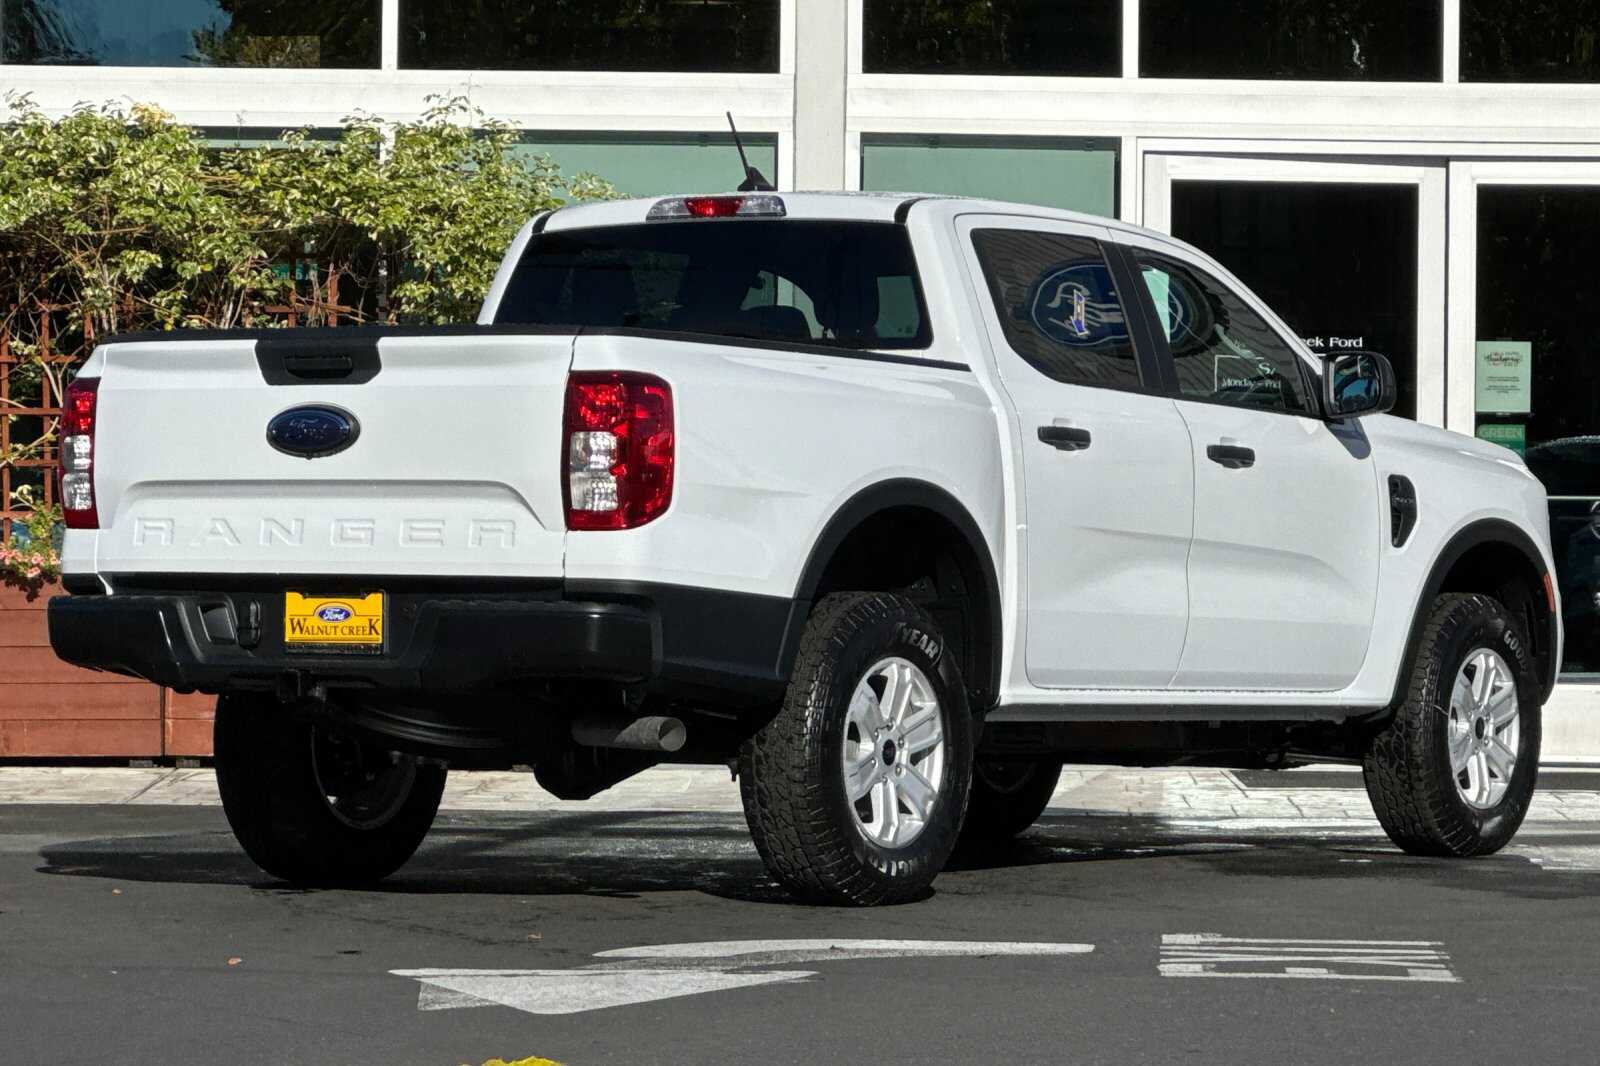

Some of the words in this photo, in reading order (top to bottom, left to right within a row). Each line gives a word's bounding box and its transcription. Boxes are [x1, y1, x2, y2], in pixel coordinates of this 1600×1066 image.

[1329, 336, 1362, 347] Ford
[132, 516, 518, 549] RANGER
[289, 617, 339, 636] WALNUT
[341, 617, 380, 636] CREEK
